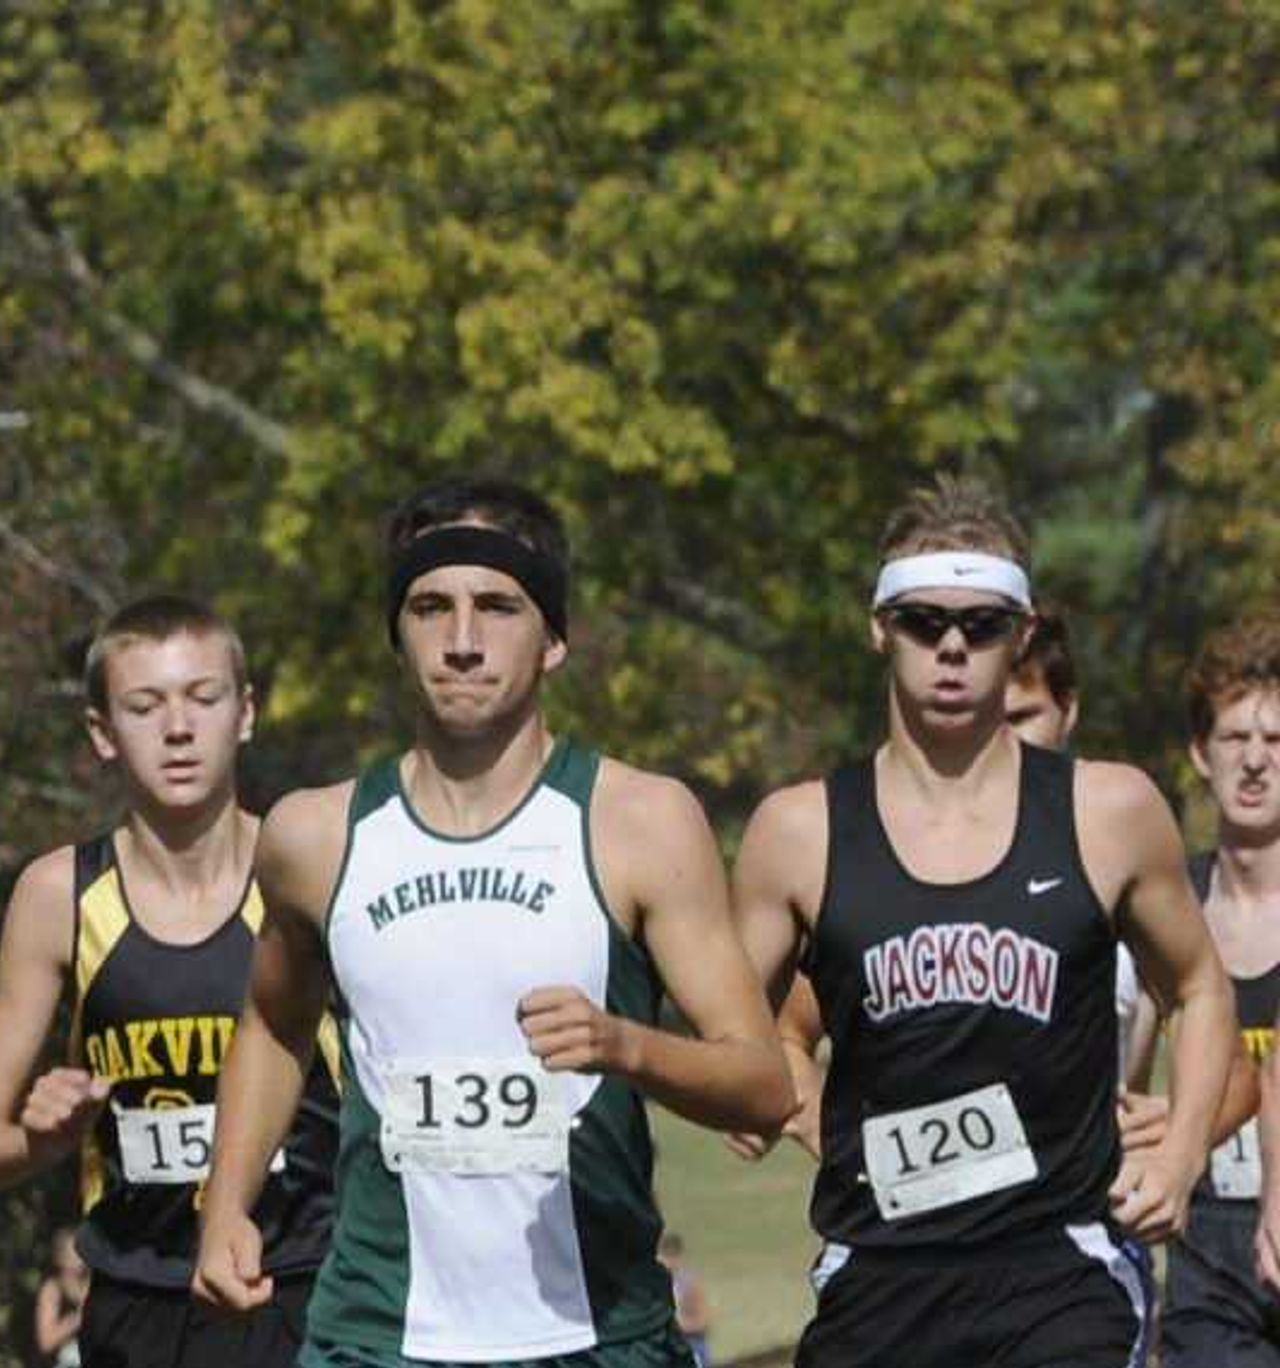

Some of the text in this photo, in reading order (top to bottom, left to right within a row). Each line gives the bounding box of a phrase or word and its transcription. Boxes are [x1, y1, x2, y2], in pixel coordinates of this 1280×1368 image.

[366, 867, 556, 931] MEHLVILLE
[863, 921, 1059, 1023] JACKSON
[414, 1073, 539, 1129] 139
[145, 1121, 210, 1170] 15
[887, 1105, 996, 1176] 120
